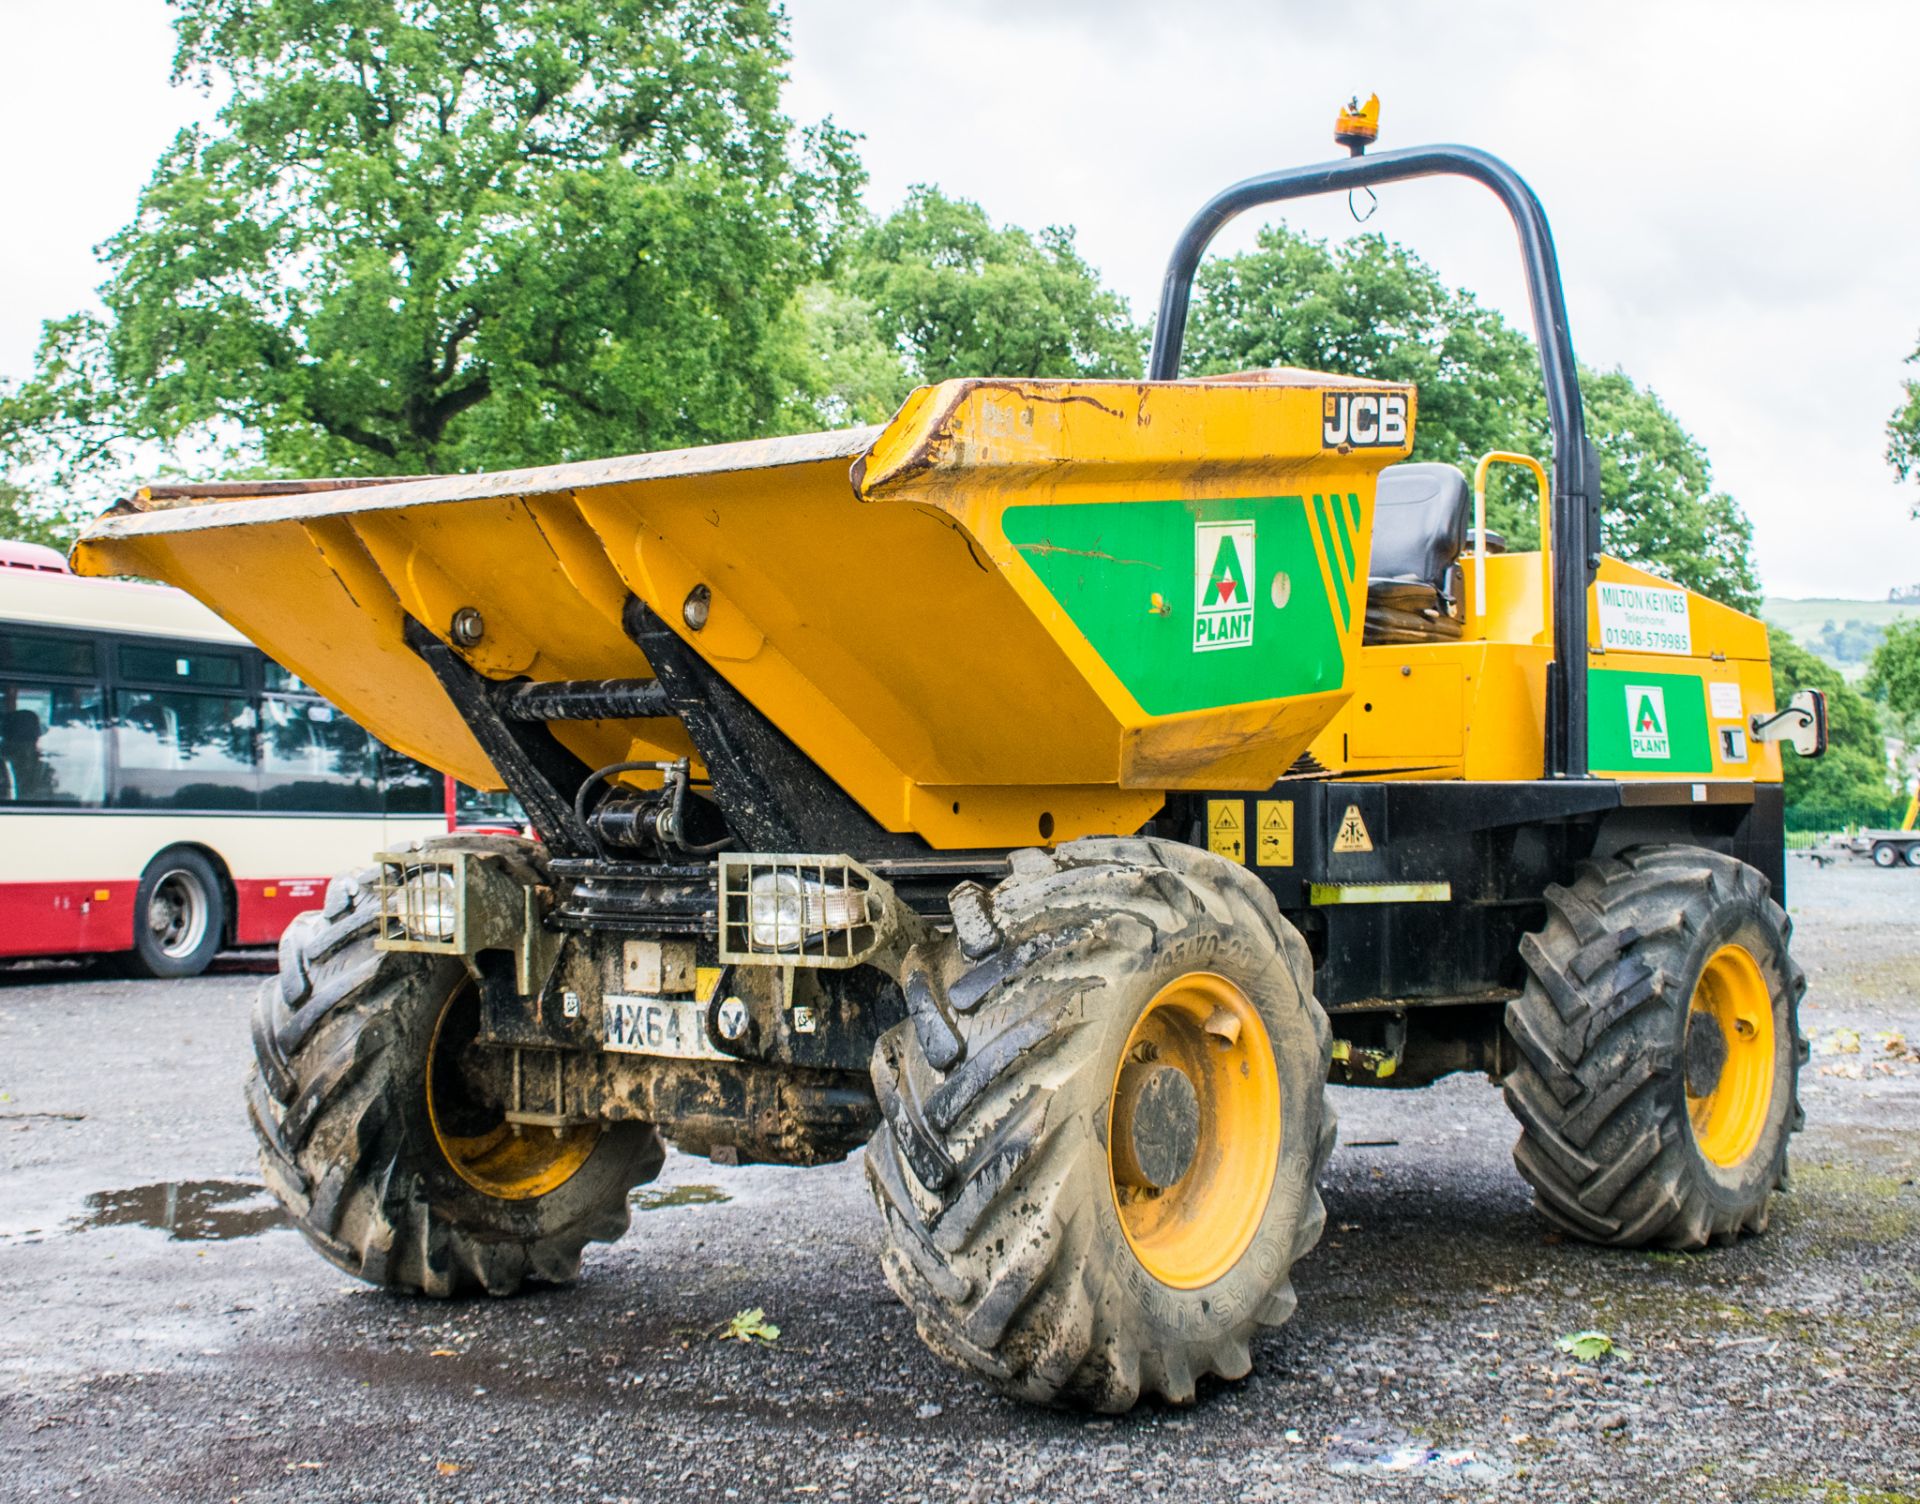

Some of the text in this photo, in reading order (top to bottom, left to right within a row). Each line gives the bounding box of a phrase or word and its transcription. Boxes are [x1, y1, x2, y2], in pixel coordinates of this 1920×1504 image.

[1324, 396, 1406, 444] JCB
[1202, 535, 1249, 606] A
[1602, 587, 1685, 614] MILTON KEYNES
[1196, 614, 1252, 643] PLANT
[1606, 628, 1688, 650] 01908-579985
[1635, 694, 1663, 733] A
[1633, 739, 1667, 753] PLANT
[603, 1004, 682, 1050] MX64
